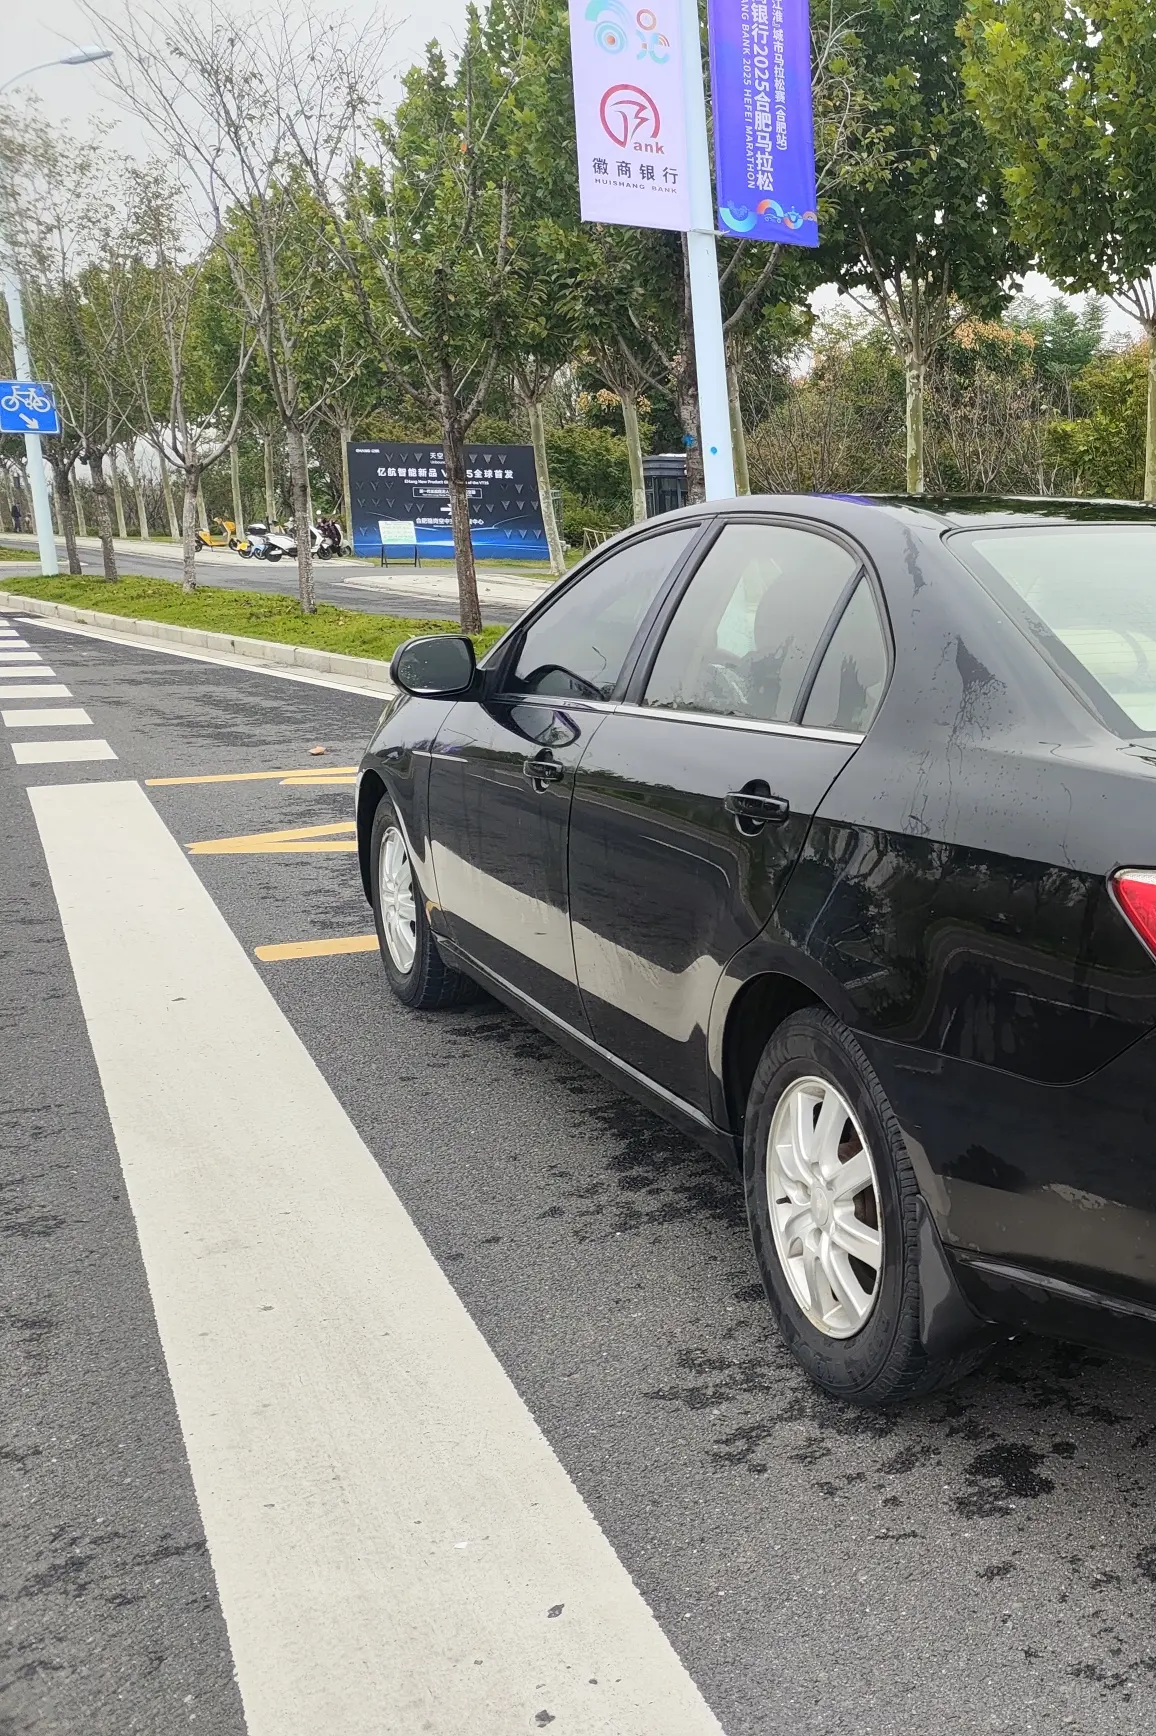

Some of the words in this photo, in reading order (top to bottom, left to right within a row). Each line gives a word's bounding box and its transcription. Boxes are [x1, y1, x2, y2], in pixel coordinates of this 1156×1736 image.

[742, 24, 751, 55] BANK
[743, 58, 752, 86] 2025
[743, 89, 753, 122] HEFEI
[751, 0, 774, 191] 银行2025合肥马拉松
[592, 157, 678, 185] 徽商银行
[745, 125, 756, 189] MARATHON
[594, 178, 645, 190] HUISHANG
[651, 186, 677, 194] BANK
